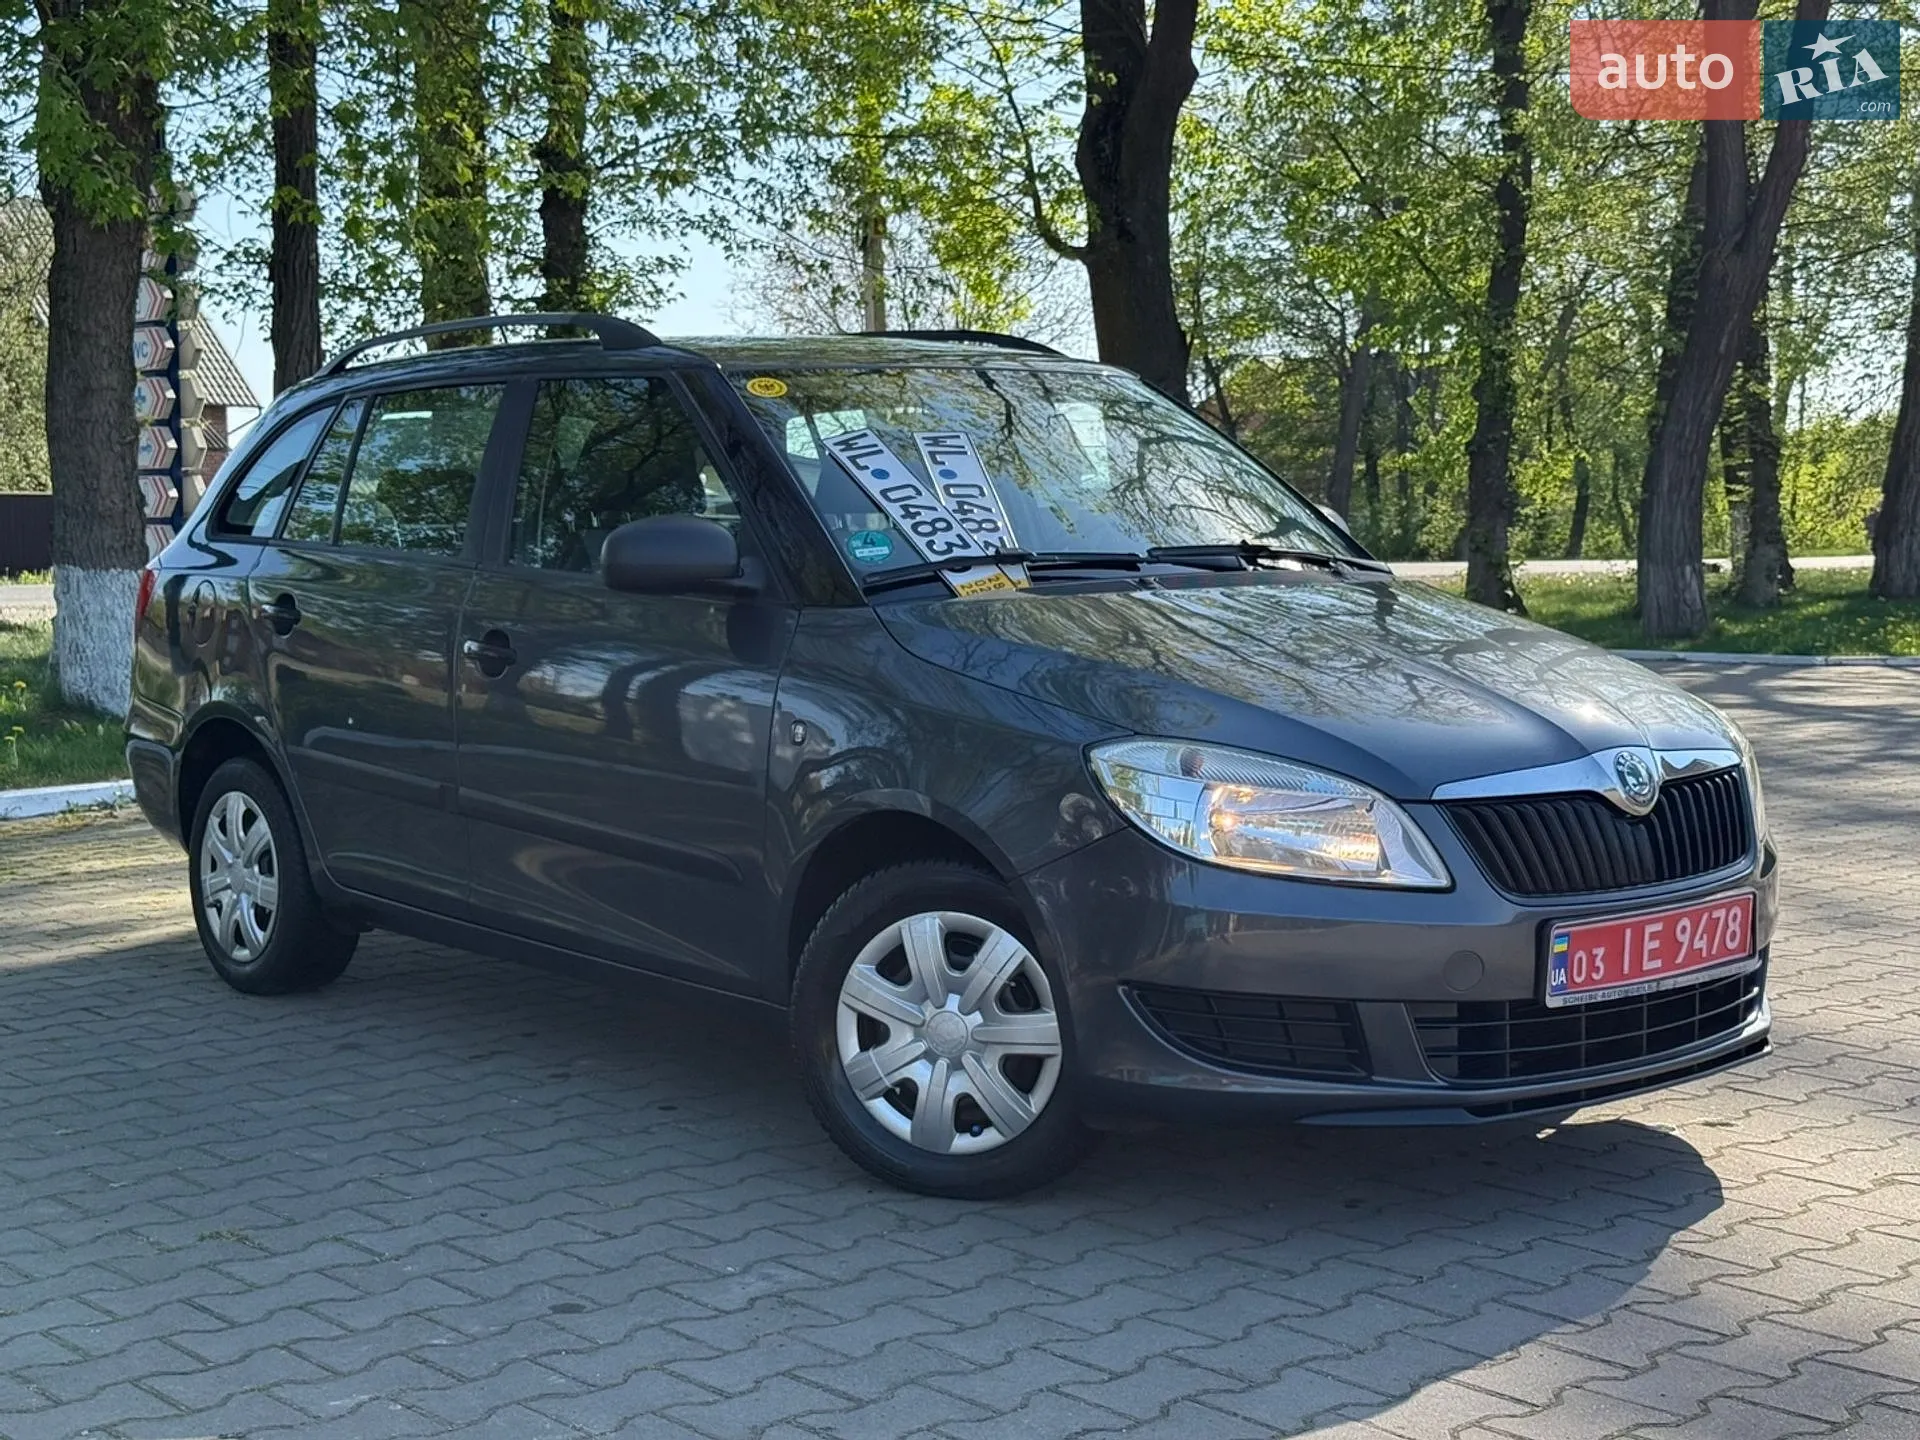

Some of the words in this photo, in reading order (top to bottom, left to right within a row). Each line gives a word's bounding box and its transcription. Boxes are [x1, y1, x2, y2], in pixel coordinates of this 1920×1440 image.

[832, 432, 884, 472] WL
[922, 434, 969, 467] WL
[1551, 968, 1567, 986] UA
[1573, 947, 1605, 984] 03
[1623, 922, 1663, 975] IE
[1675, 905, 1742, 964] 9478
